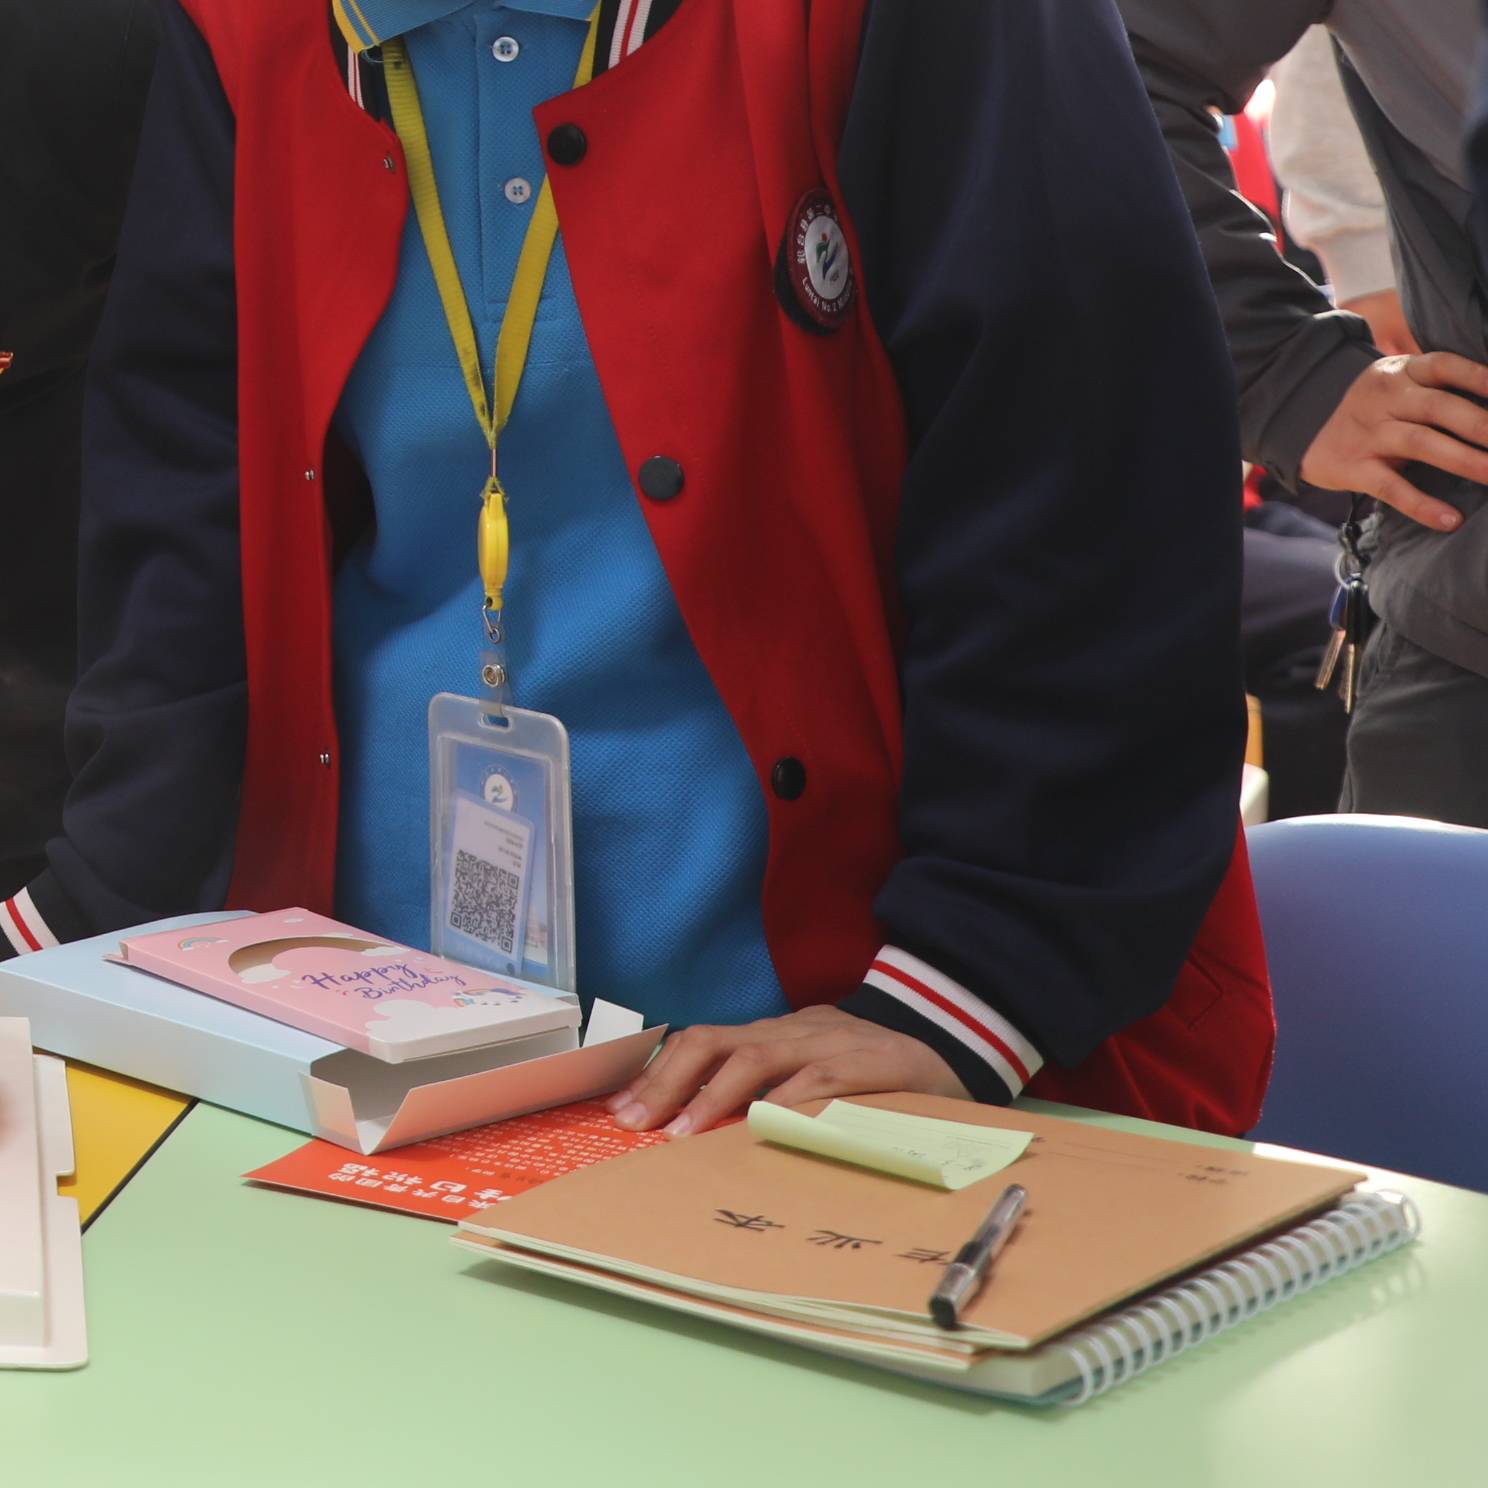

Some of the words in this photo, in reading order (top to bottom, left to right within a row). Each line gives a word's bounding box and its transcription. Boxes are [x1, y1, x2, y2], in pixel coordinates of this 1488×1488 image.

[301, 962, 419, 990] Happy
[354, 973, 467, 1000] Birthday
[328, 1172, 497, 1210] 来自共青团的
[338, 1163, 512, 1201] 生日祝福
